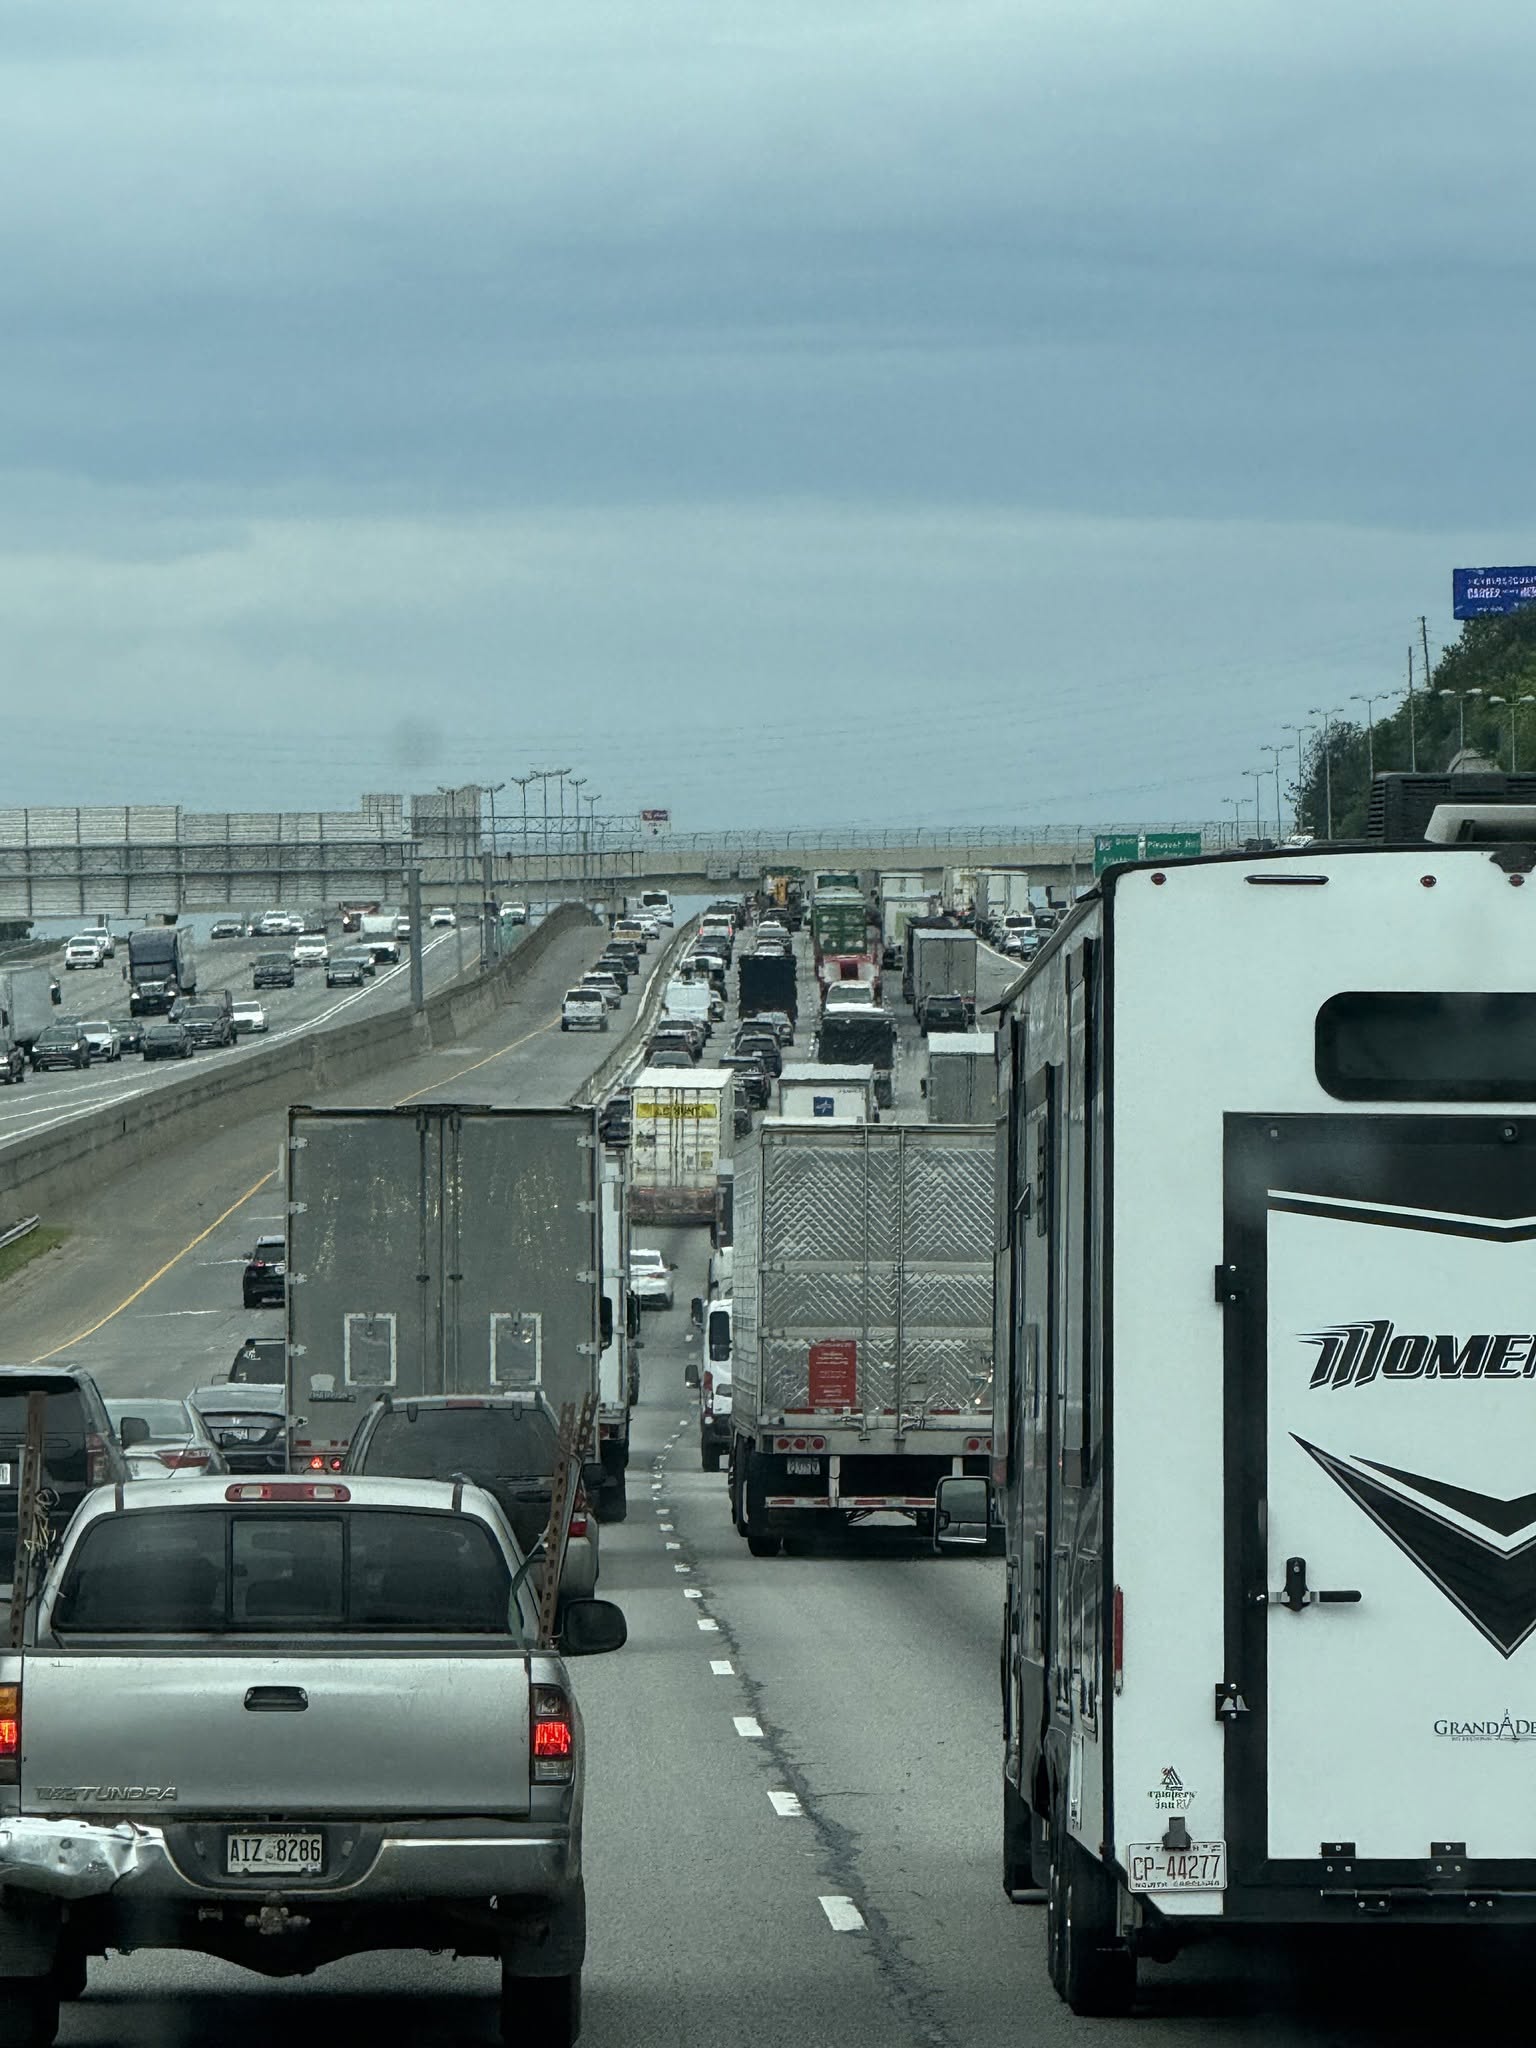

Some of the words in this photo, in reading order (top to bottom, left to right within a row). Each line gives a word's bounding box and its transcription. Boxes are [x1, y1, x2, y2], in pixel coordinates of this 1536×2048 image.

[1296, 1320, 1536, 1390] MOME
[1434, 1719, 1499, 1735] GRAND
[76, 1786, 178, 1801] TUNDRA
[230, 1838, 261, 1861] AIZ
[276, 1838, 321, 1862] 8286
[1133, 1854, 1221, 1881] CP-44277
